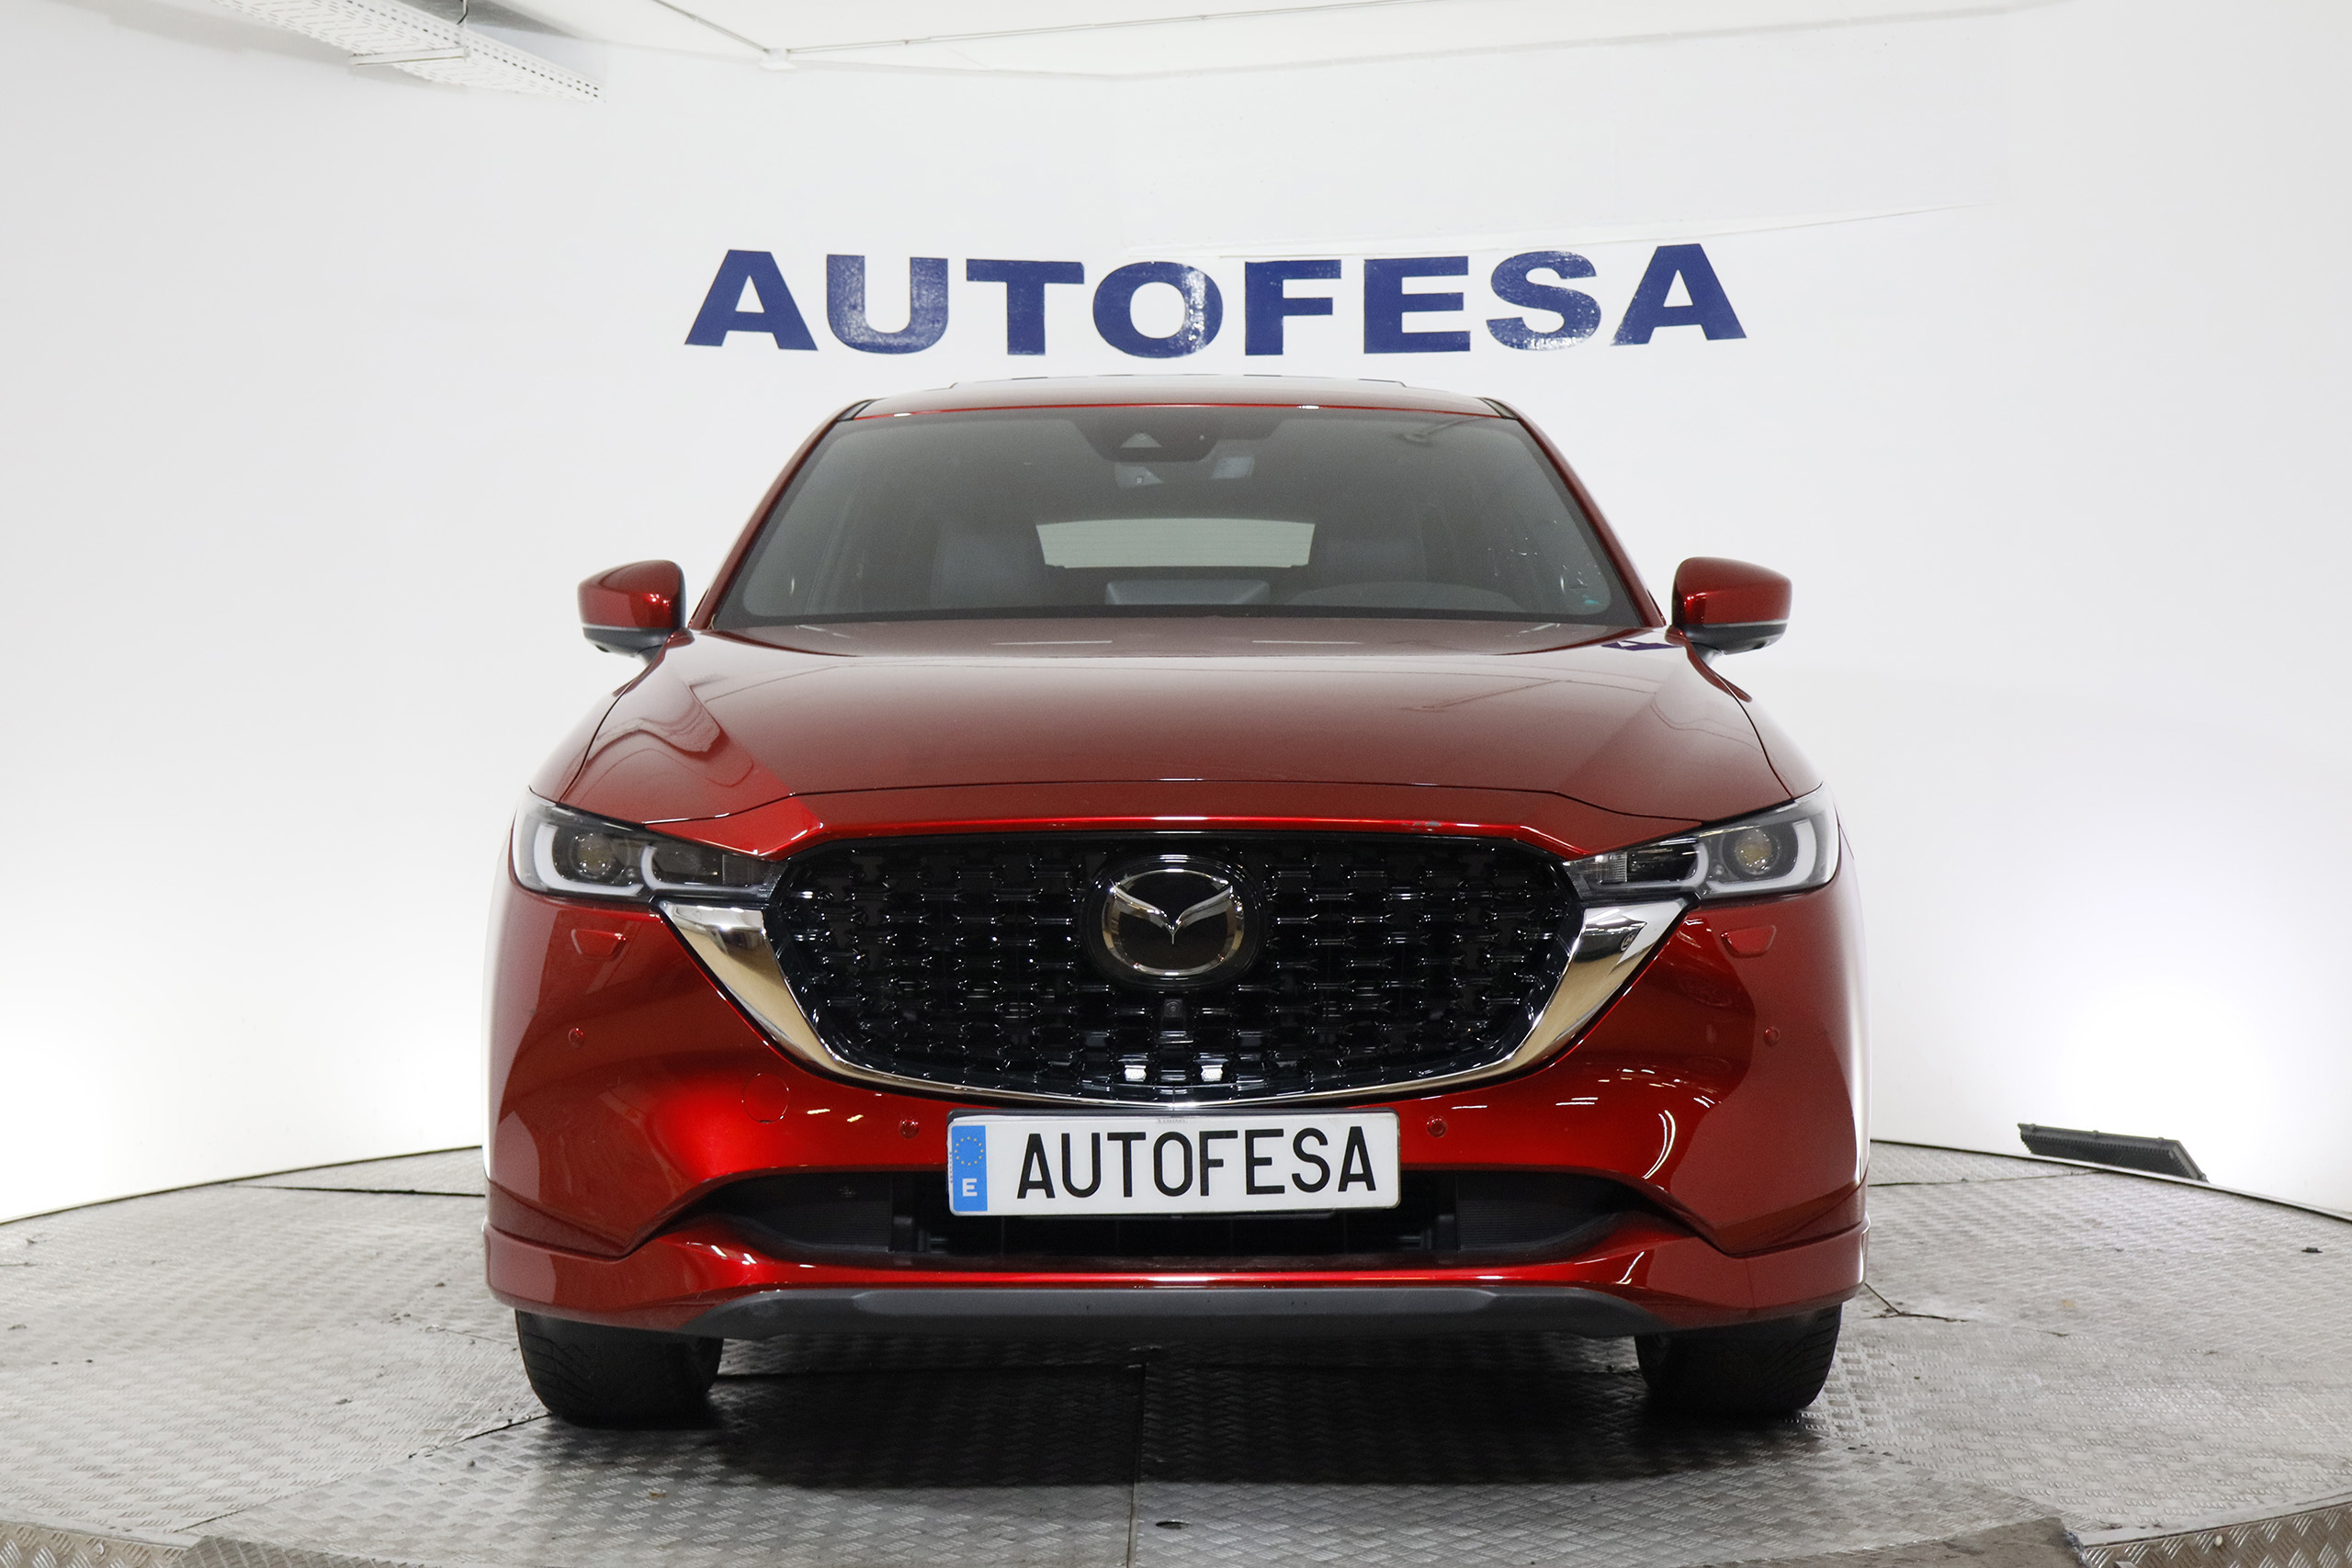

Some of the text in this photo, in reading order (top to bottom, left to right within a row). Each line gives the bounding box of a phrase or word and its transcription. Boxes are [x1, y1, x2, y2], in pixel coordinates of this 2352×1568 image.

[685, 243, 1747, 358] AUTOFESA
[962, 1178, 978, 1197] E
[1017, 1126, 1376, 1200] AUTOFESA
